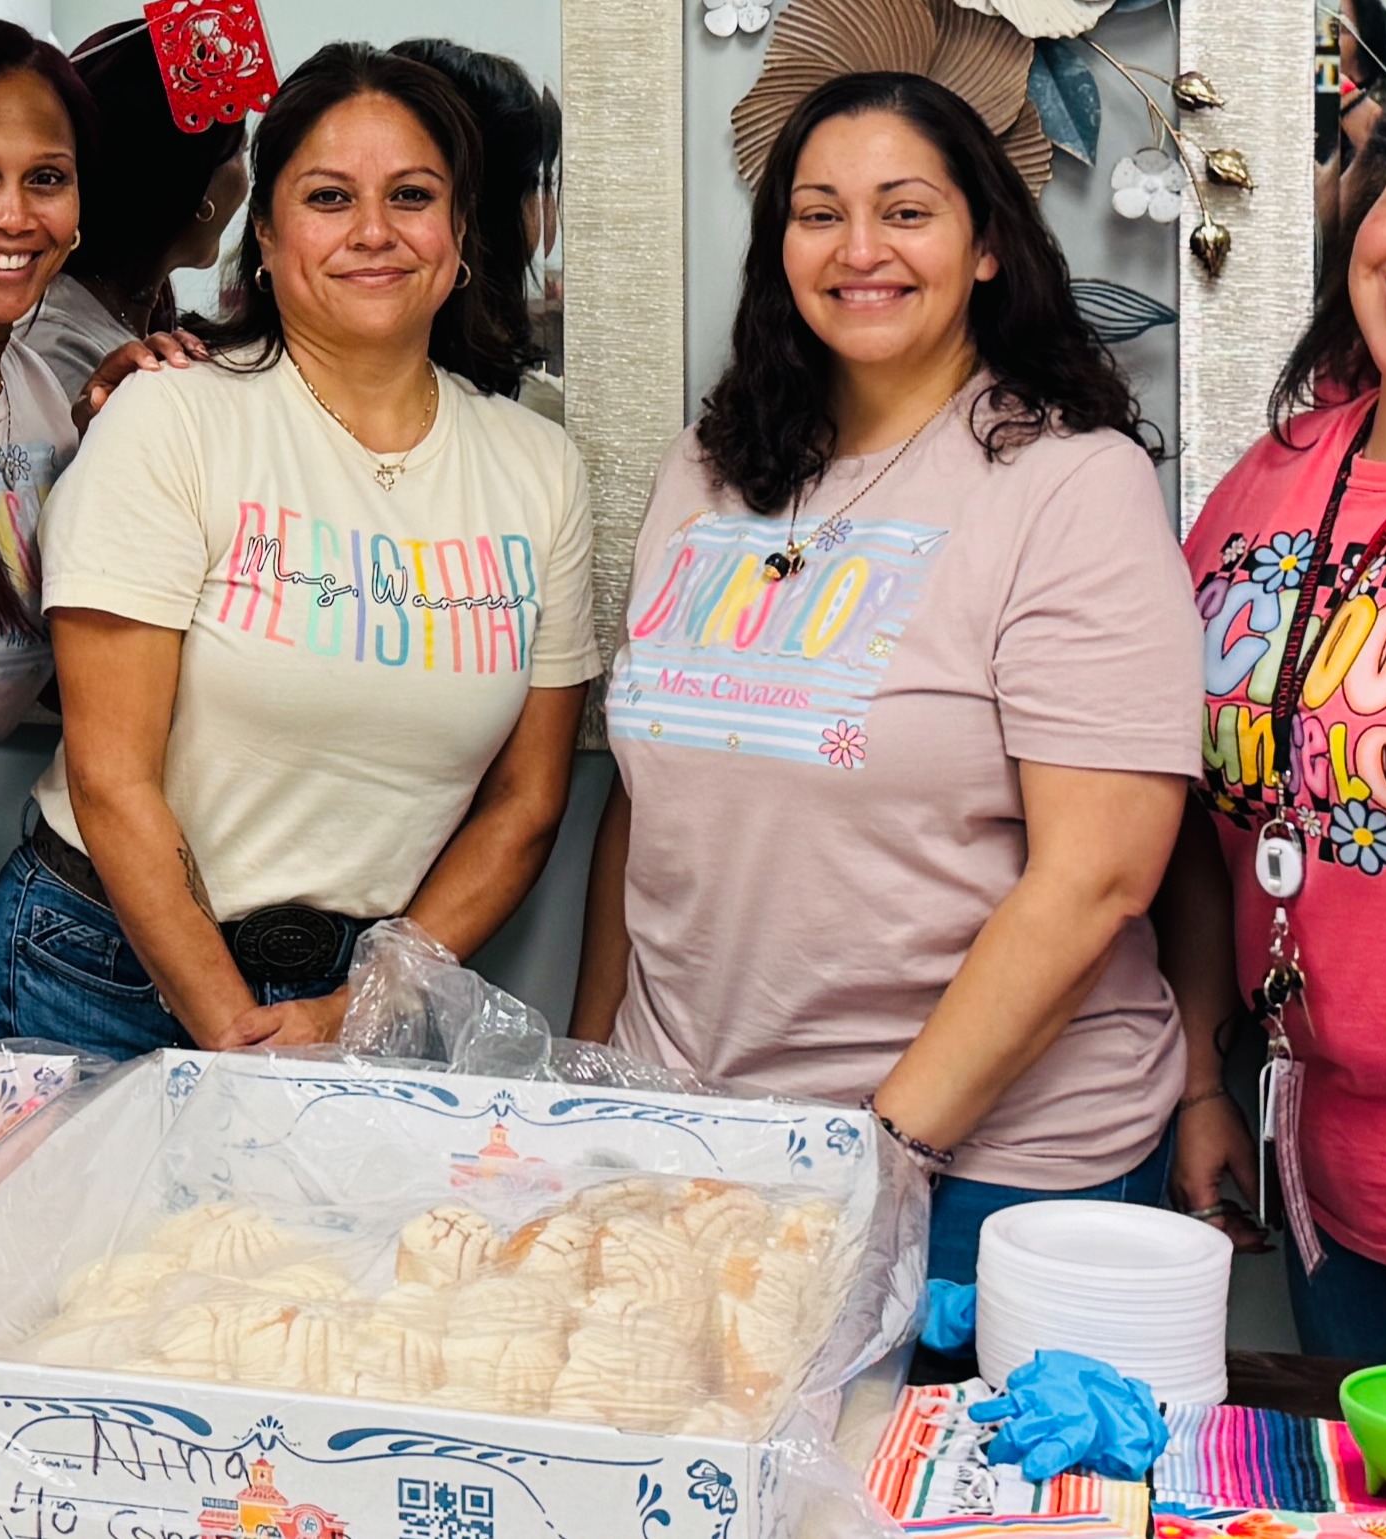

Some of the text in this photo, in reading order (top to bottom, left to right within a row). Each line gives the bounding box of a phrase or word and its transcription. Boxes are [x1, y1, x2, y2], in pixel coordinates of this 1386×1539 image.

[217, 501, 541, 675] REGISTRAR
[241, 533, 359, 608] Mrs.
[656, 667, 812, 710] Mrs. Cavazos
[90, 1412, 252, 1488] Nina
